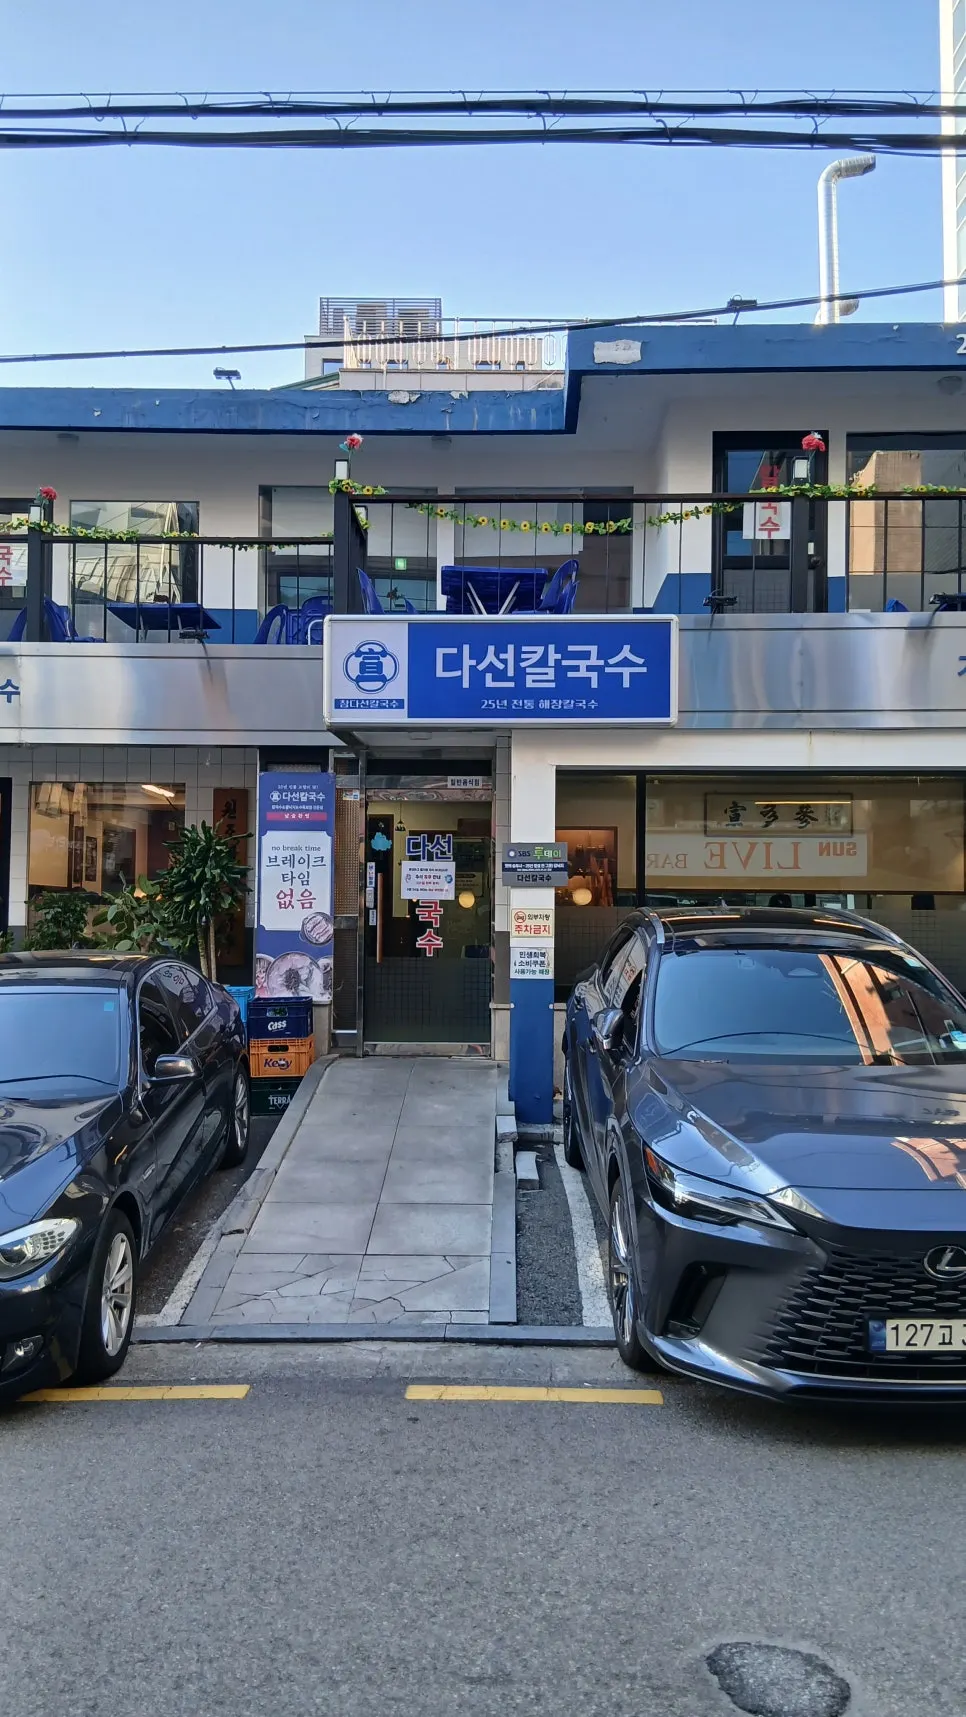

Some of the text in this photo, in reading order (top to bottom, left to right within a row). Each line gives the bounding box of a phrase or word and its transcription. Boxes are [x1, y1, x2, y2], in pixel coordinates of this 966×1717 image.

[435, 643, 648, 689] 다선칼국수
[339, 700, 399, 709] 참다선칼국수
[481, 700, 599, 710] 25년 전통 해장칼국수
[282, 791, 326, 802] 다선칼국수
[282, 844, 303, 852] break
[406, 834, 453, 861] 다선
[265, 854, 327, 870] 브레이크
[281, 870, 310, 887] 타임
[517, 874, 552, 882] 다선칼국수
[275, 888, 317, 910] 없음
[514, 924, 550, 935] 주차금지
[519, 951, 546, 959] 민생회복
[267, 1020, 287, 1031] Cass
